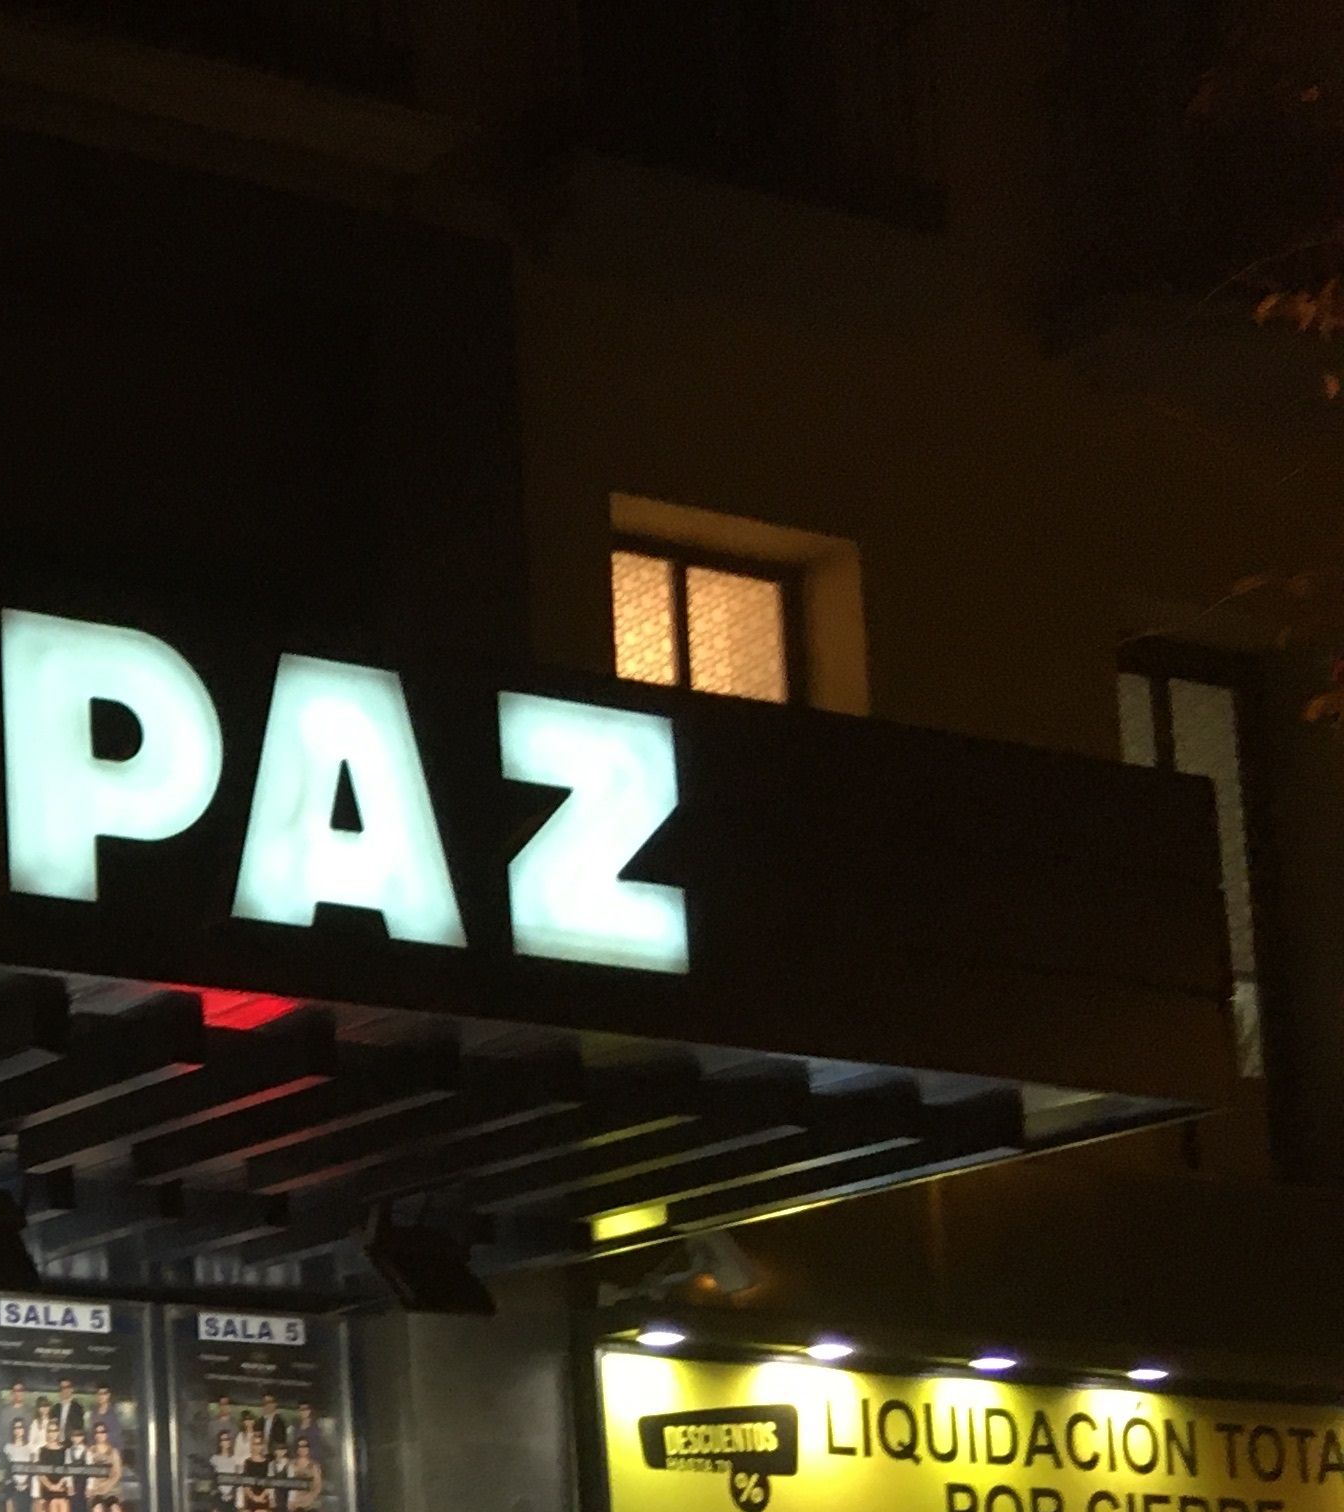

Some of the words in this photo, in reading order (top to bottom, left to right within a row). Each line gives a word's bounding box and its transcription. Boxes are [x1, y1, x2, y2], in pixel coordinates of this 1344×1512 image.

[0, 607, 691, 975] PAZ
[4, 1302, 79, 1329] SALA
[89, 1310, 106, 1330] 5
[204, 1316, 271, 1342] SALA
[285, 1322, 301, 1342] 5
[664, 1421, 778, 1455] DESCUENTOS
[826, 1397, 1200, 1479] LIQUIDACIÓN
[735, 1472, 764, 1503] %
